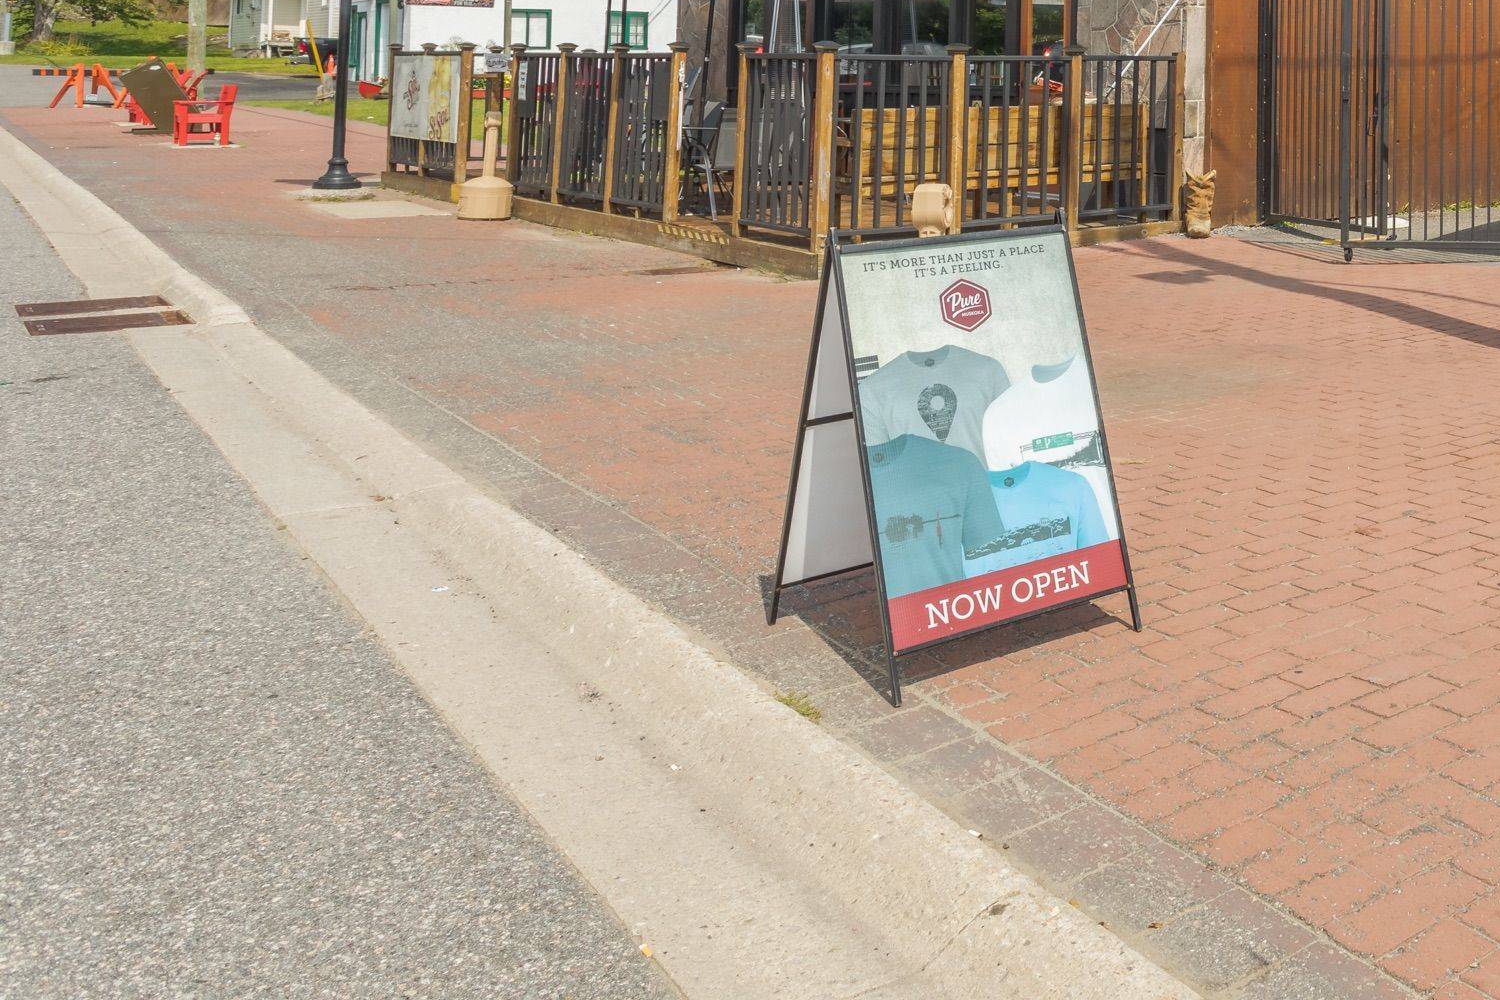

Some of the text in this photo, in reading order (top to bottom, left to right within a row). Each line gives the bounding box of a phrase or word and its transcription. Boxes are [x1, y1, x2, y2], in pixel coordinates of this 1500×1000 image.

[863, 244, 1045, 272] IT'S MORE THAN JUST A PLACE
[914, 260, 1004, 278] IT'S A FEELING.
[946, 292, 982, 312] Pure
[925, 560, 1090, 629] NOW OPEN
